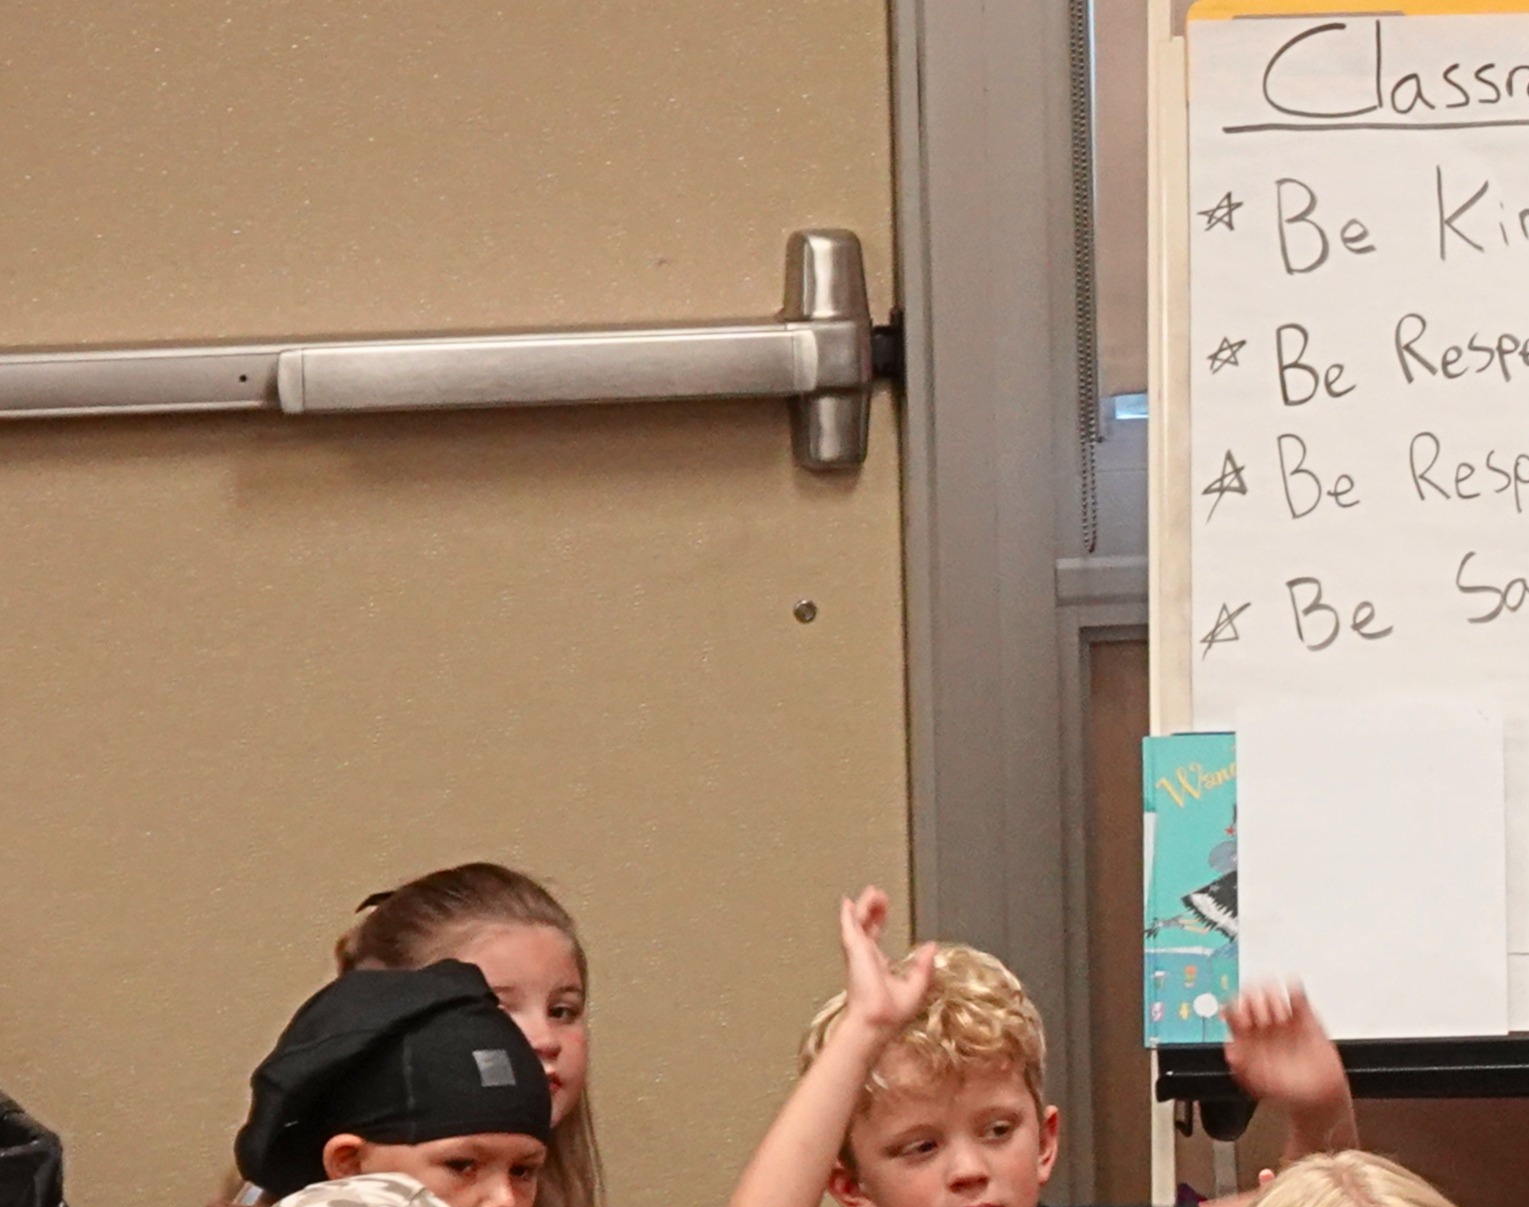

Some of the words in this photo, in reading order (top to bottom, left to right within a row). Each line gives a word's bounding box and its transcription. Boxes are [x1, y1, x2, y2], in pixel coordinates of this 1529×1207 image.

[1275, 177, 1376, 275] Be
[1276, 322, 1358, 406] Be
[1277, 433, 1361, 519] Be
[1285, 576, 1394, 653] Be
